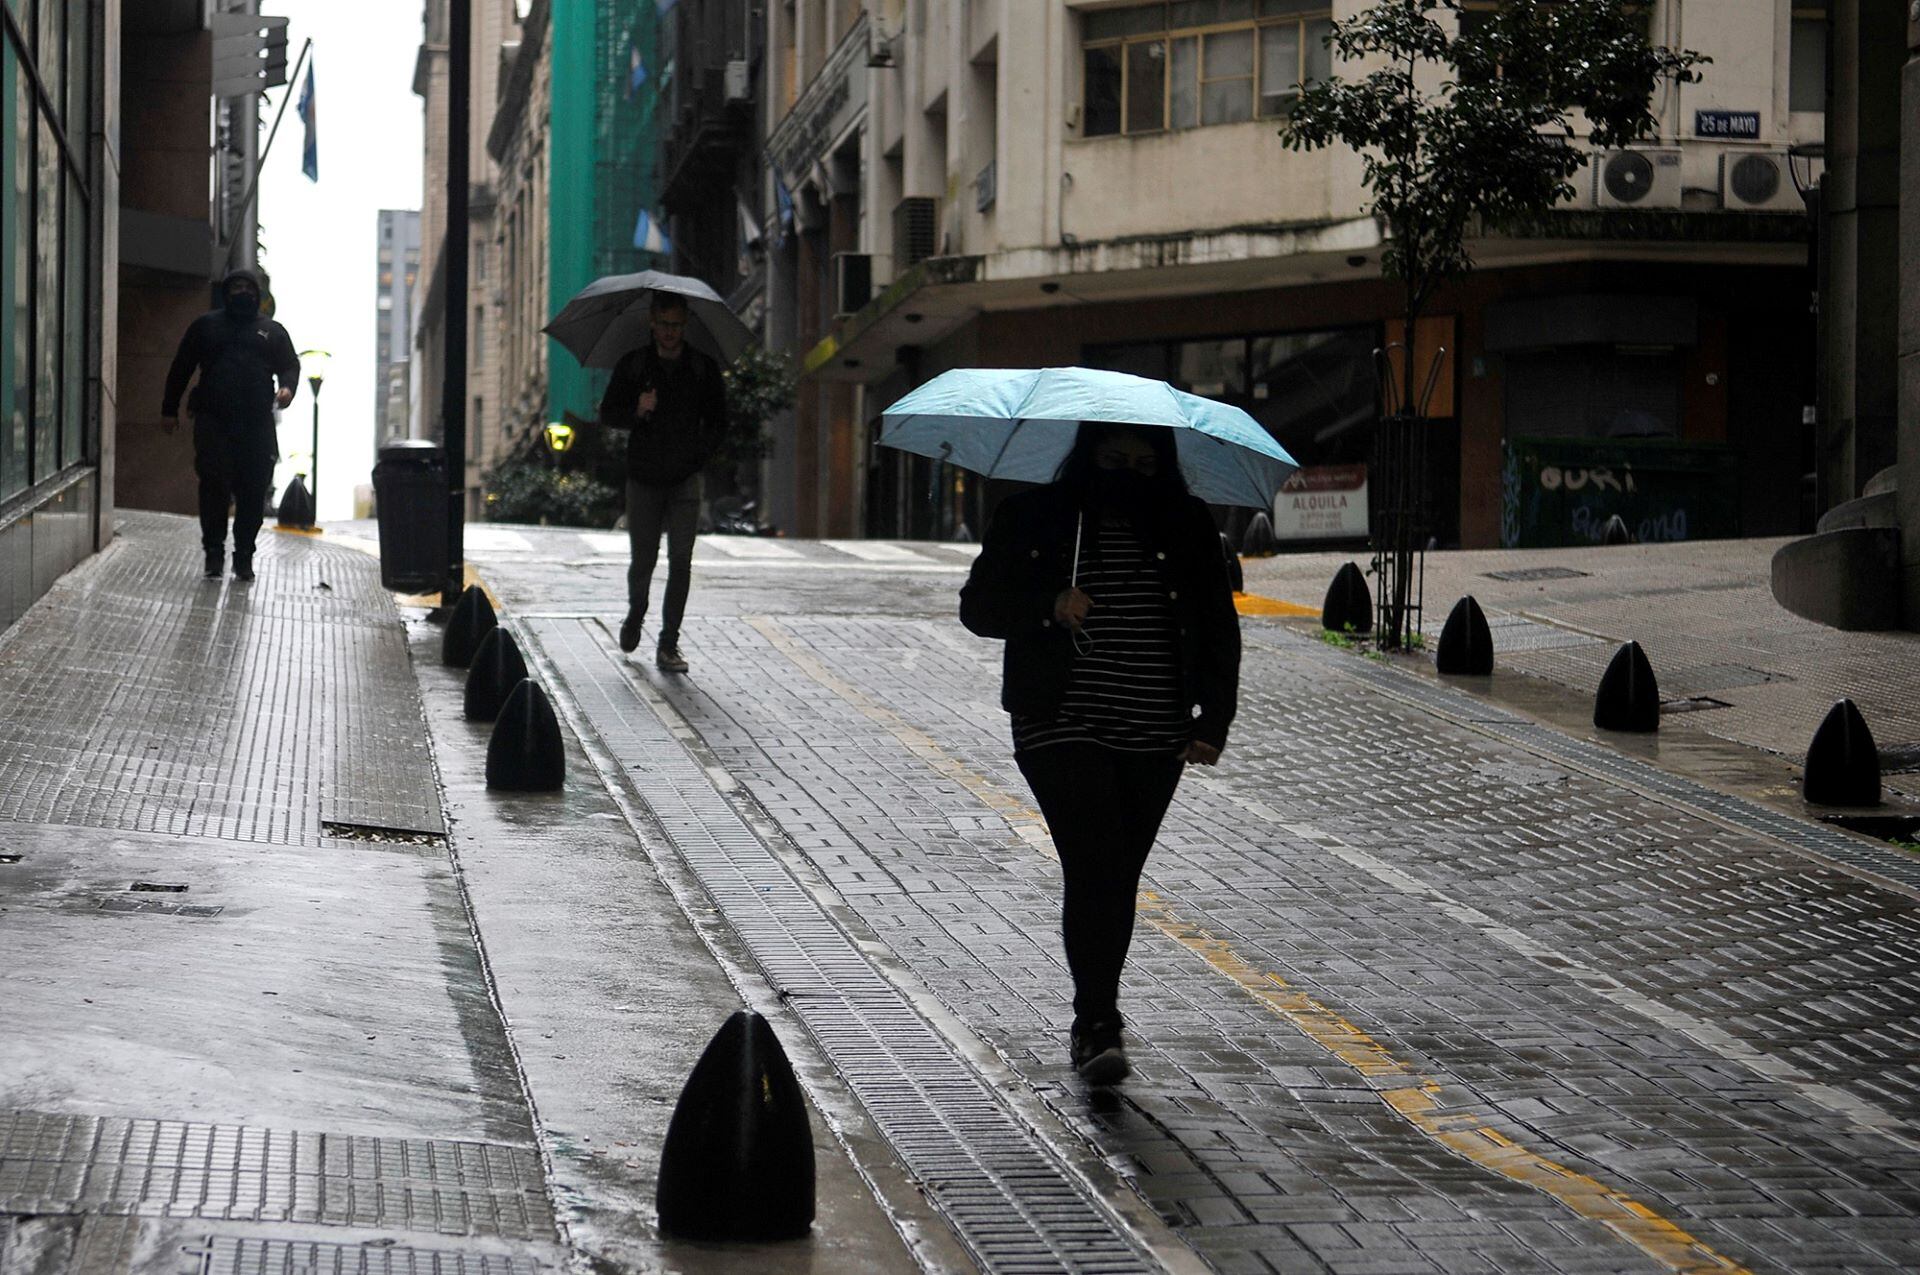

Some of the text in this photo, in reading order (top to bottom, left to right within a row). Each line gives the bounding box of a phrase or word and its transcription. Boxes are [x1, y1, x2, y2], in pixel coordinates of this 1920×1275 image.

[1701, 115, 1716, 133] 25
[1729, 115, 1756, 134] MAYO
[1293, 494, 1348, 510] ALQUILA
